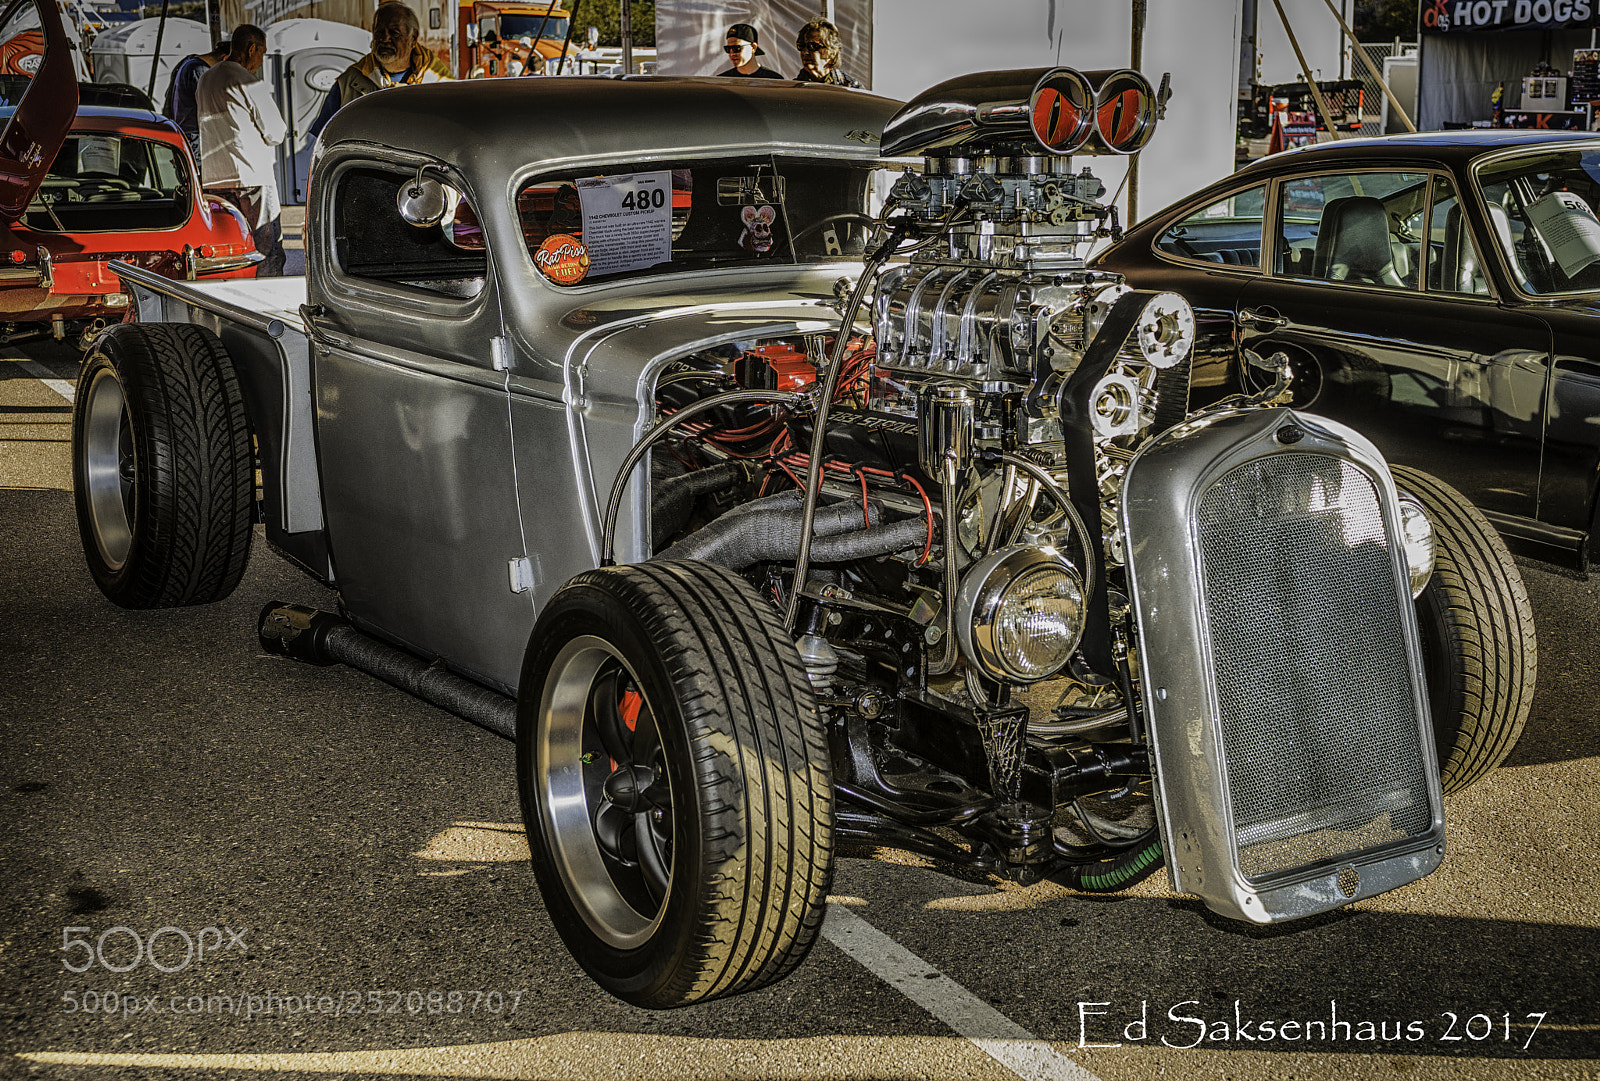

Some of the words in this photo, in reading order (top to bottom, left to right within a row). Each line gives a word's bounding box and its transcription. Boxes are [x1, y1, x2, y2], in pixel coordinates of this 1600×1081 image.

[1454, 1, 1508, 26] HOT
[1514, 0, 1591, 24] DOGS
[622, 188, 665, 210] 480
[537, 249, 561, 267] Rat
[560, 243, 587, 261] Piss
[555, 267, 578, 277] FUEL
[857, 416, 919, 437] STROKE
